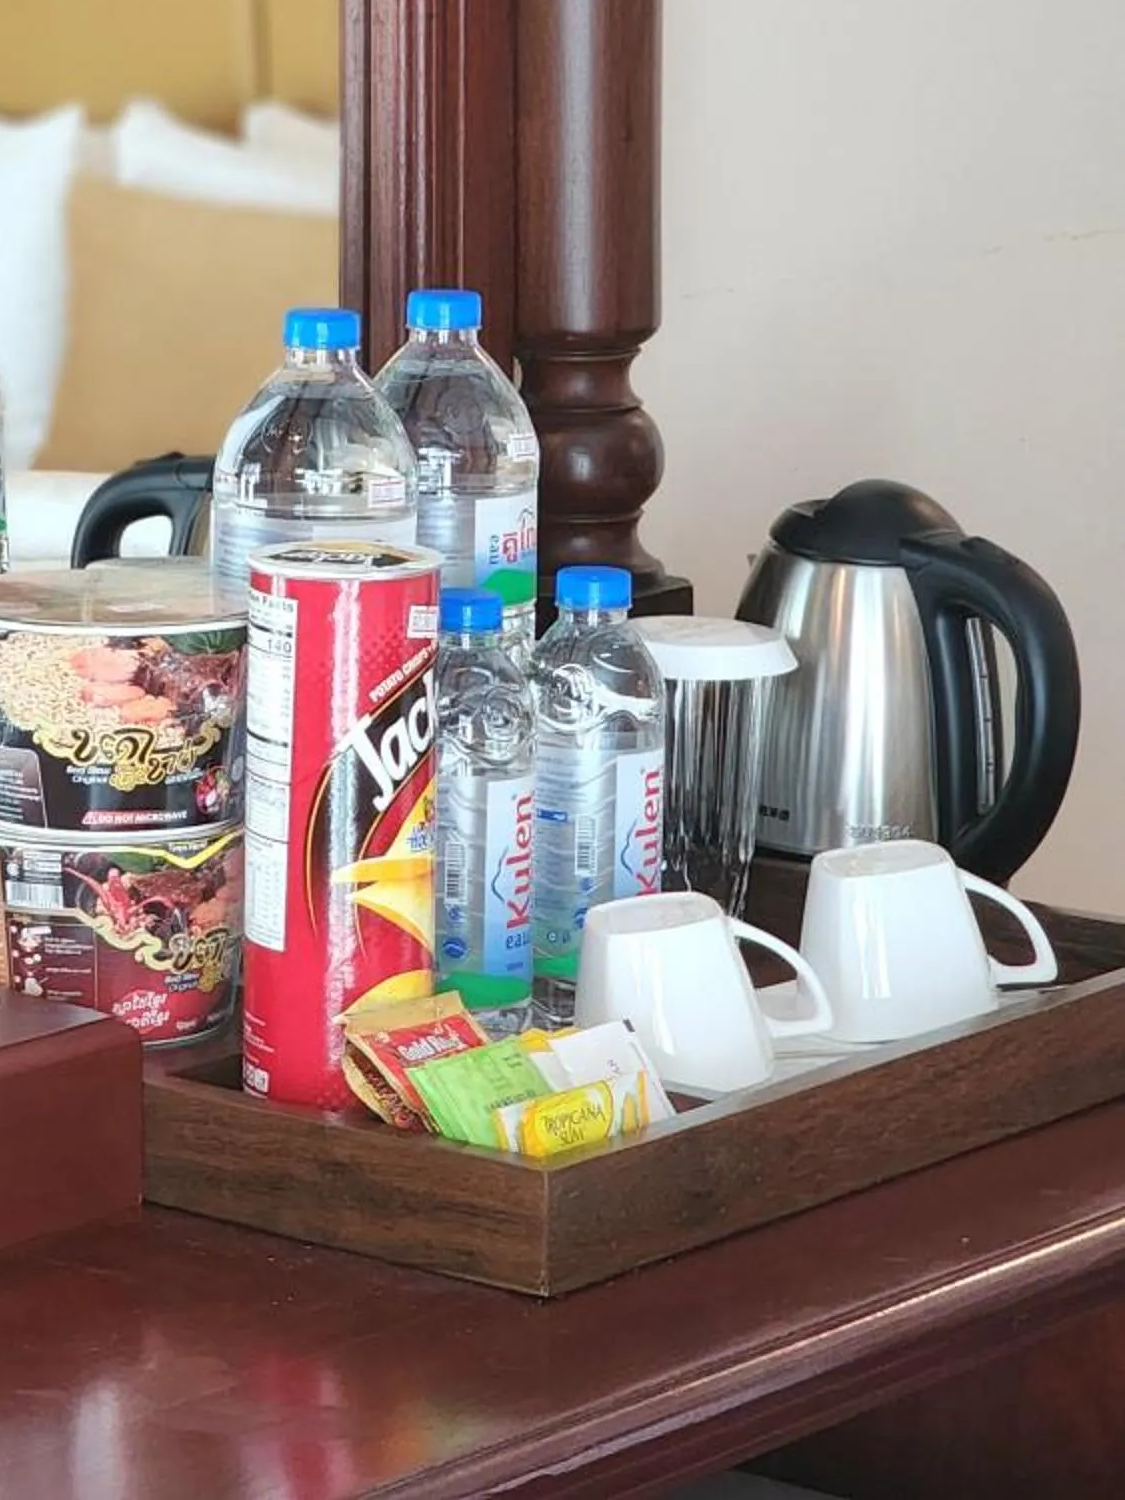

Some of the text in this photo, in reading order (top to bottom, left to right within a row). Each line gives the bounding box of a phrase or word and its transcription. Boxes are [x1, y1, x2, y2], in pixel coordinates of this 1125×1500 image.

[506, 794, 533, 930] Kulen
[634, 769, 661, 897] Kulen
[539, 1103, 606, 1136] TROPICANA
